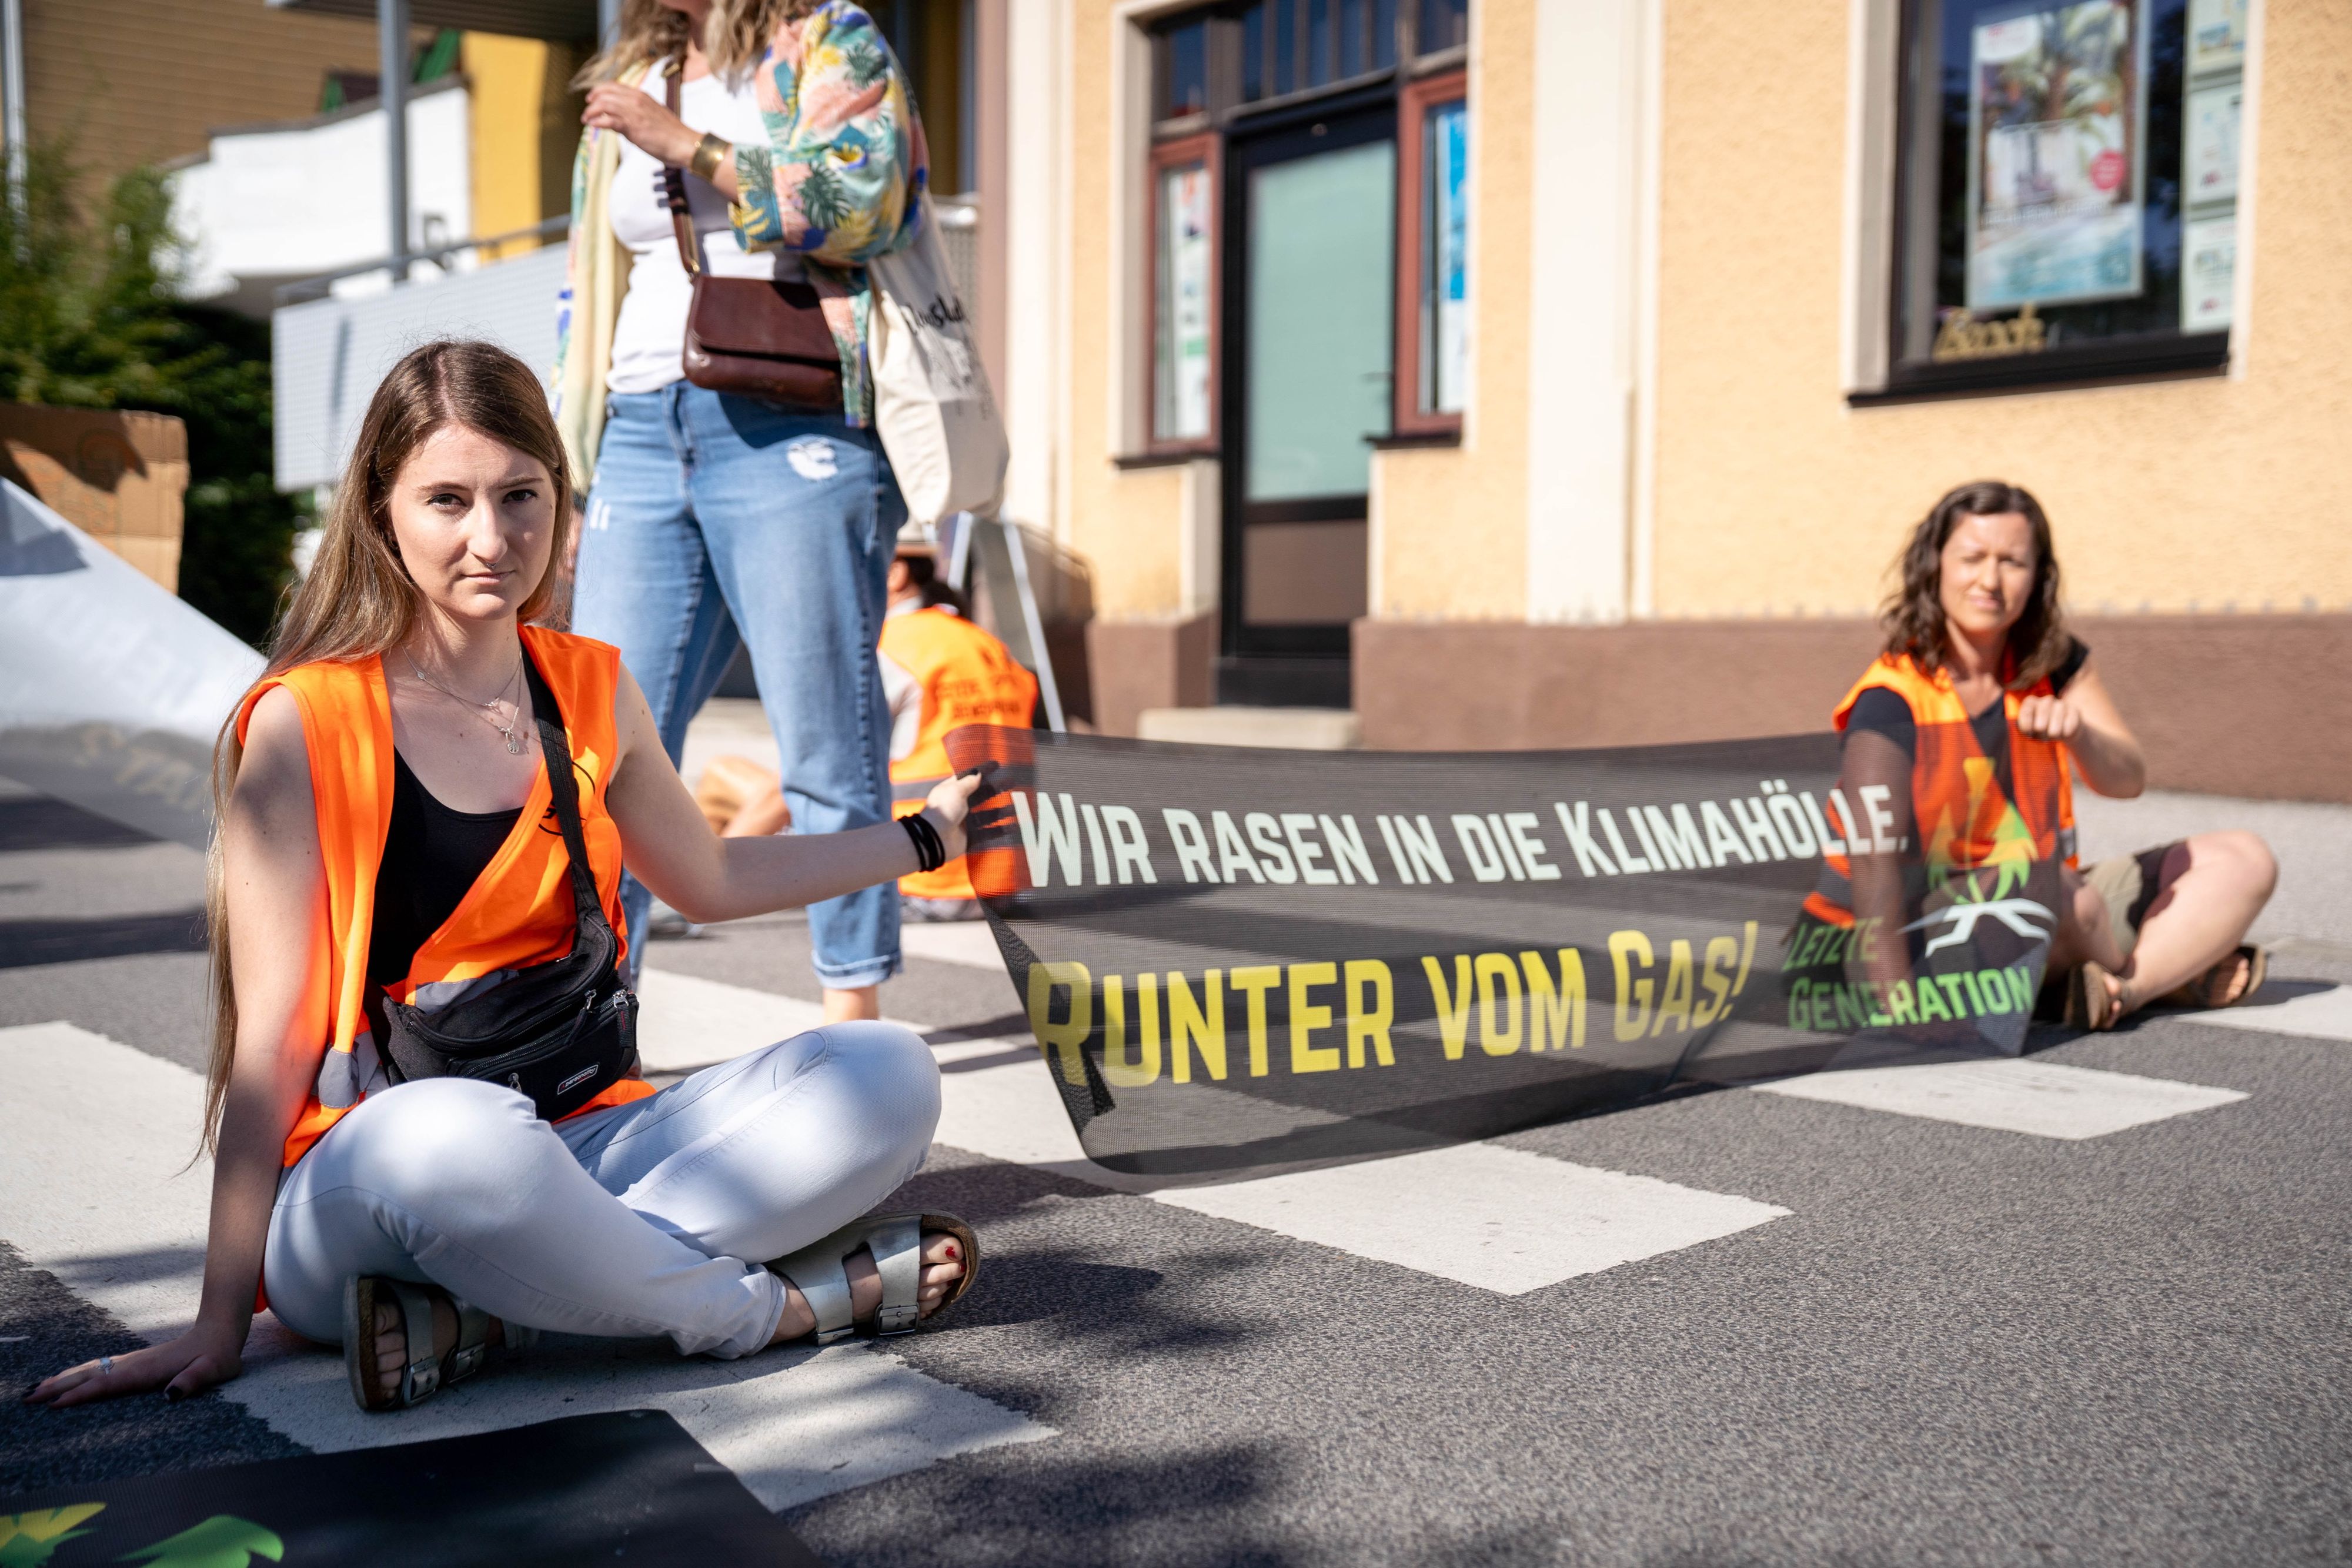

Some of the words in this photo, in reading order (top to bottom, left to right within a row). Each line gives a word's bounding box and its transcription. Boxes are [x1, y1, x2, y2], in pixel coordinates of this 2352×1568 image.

[1011, 791, 1158, 887] WIR
[1162, 808, 1379, 885] RASEN
[1376, 814, 1454, 884] IN
[1451, 812, 1562, 883] DIE
[1780, 915, 1883, 972] LETZTE
[1028, 959, 1395, 1087] RUNTER
[1421, 947, 1586, 1061] VOM
[1608, 921, 1758, 1042] GAS!
[1788, 965, 2034, 1031] GENERATION
